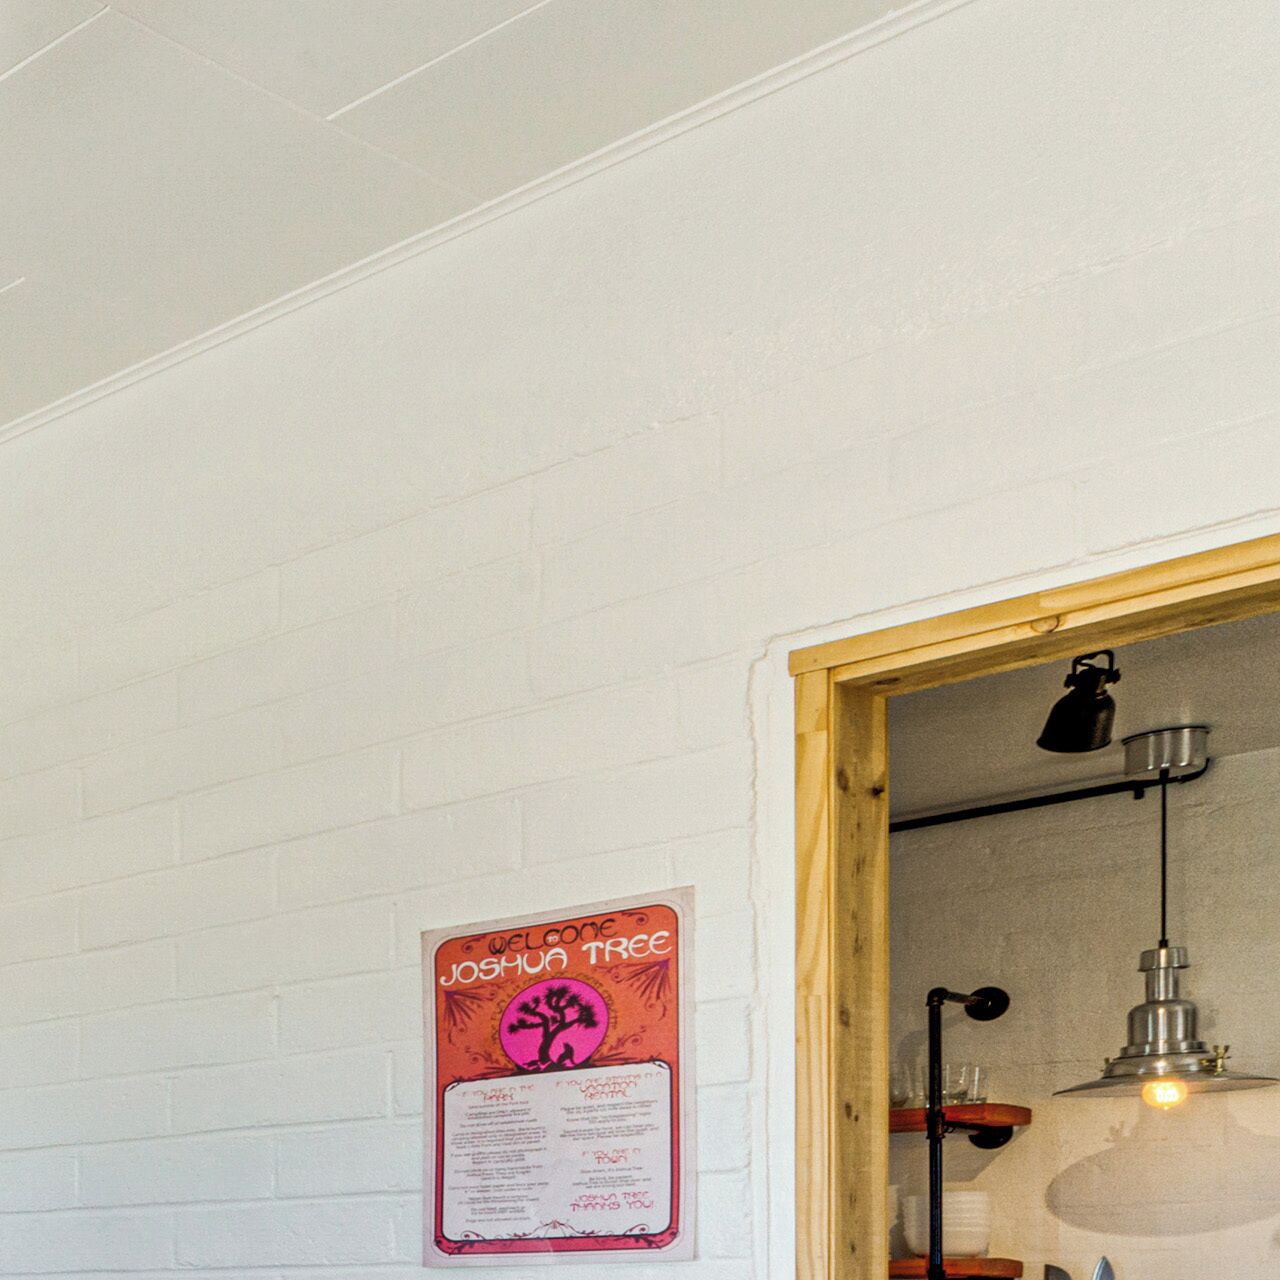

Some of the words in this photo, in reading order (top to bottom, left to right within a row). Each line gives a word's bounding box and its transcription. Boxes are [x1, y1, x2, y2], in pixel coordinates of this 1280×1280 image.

[440, 947, 568, 986] JOSHUA
[582, 930, 672, 966] TREE
[489, 918, 618, 956] WELCOME
